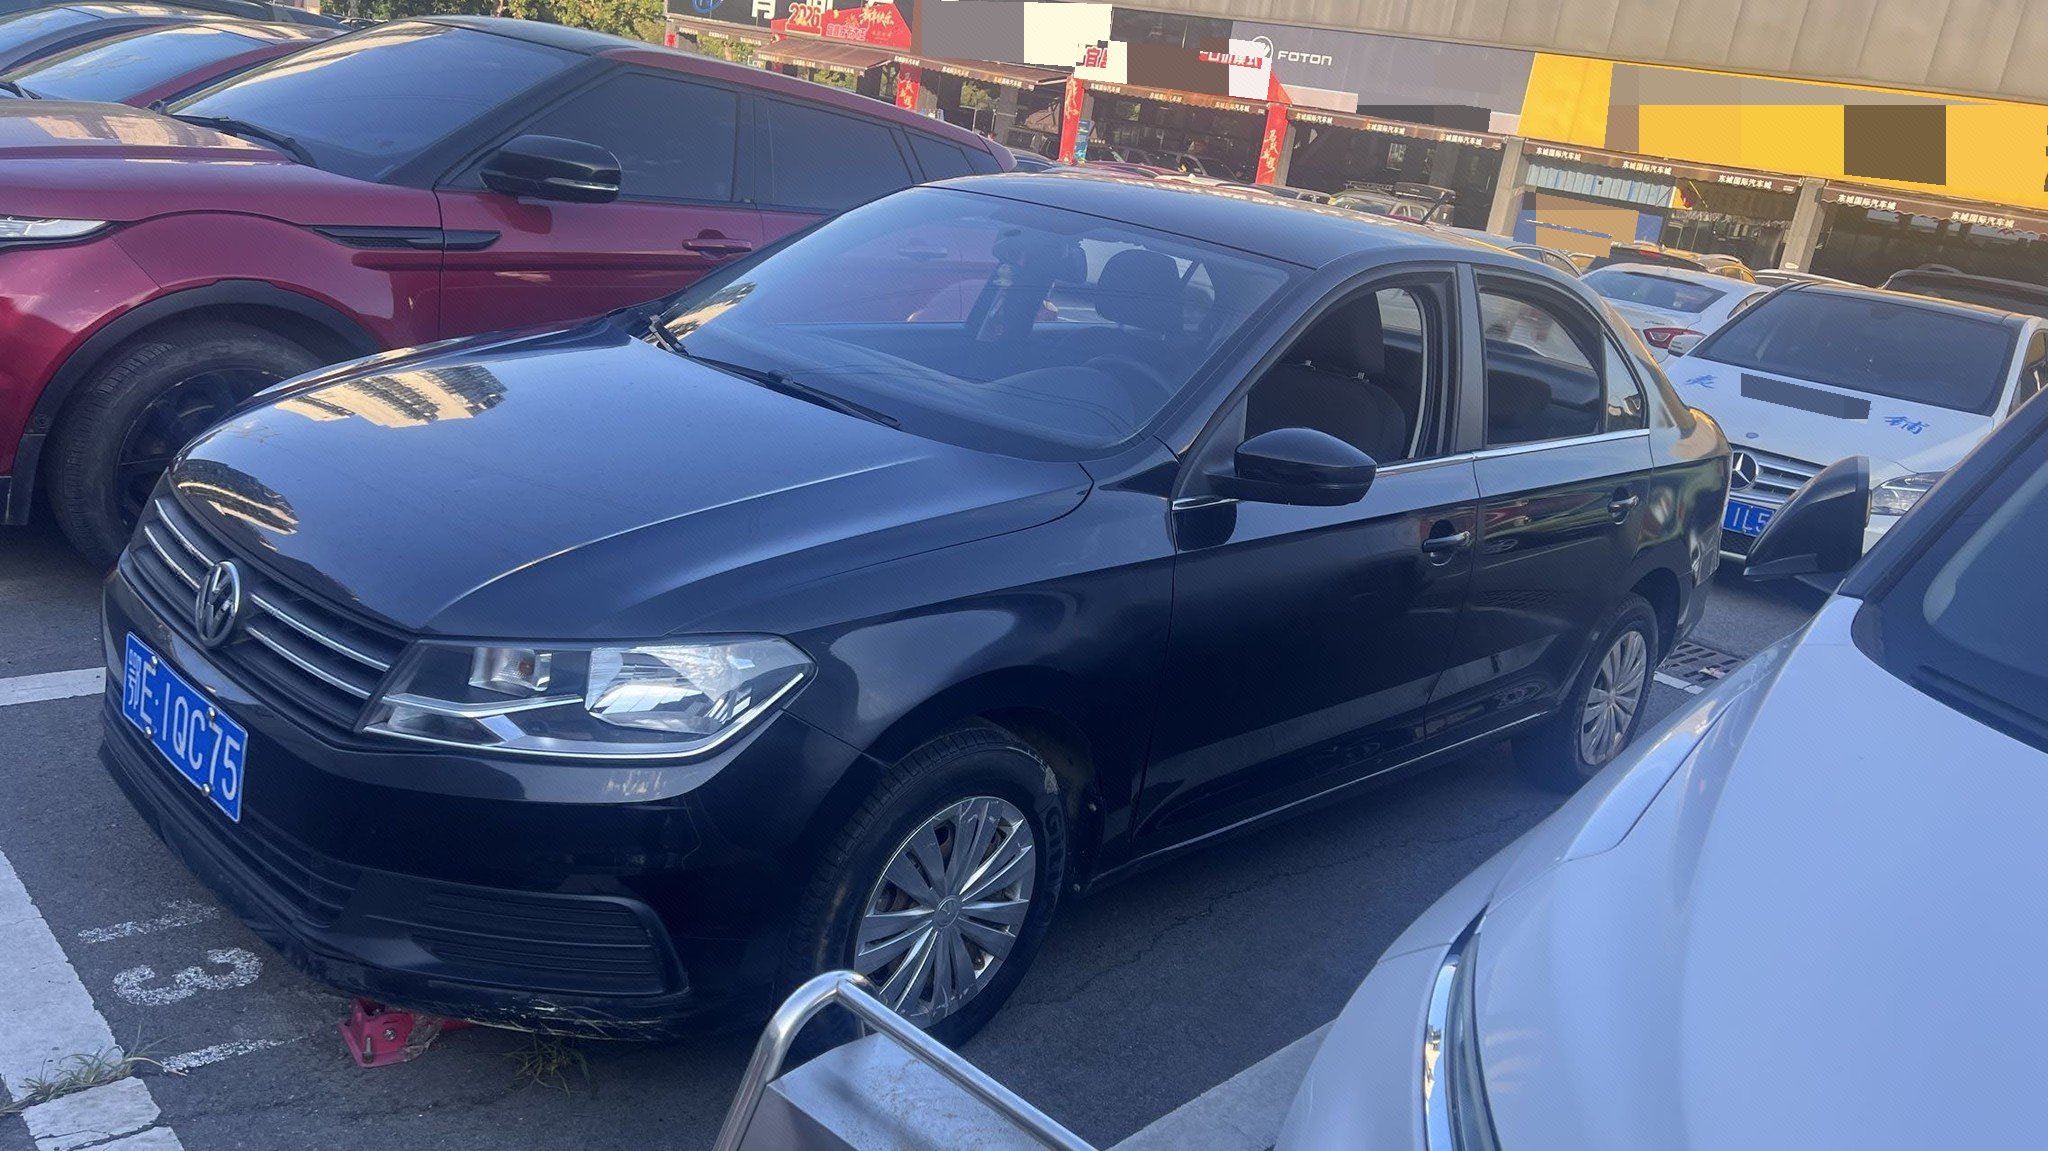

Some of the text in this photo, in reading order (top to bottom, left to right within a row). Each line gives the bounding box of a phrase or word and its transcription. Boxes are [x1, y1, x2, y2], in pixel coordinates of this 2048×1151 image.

[787, 3, 821, 28] 2026
[1278, 50, 1332, 66] FOTON
[1536, 147, 1581, 161] 东城国际汽车城
[1622, 160, 1672, 175] 东城国际汽车城
[1718, 174, 1773, 190] 东城国际汽车城
[1838, 193, 1897, 211] 东城国际汽车城
[1951, 210, 2015, 229] 东城国际汽车城
